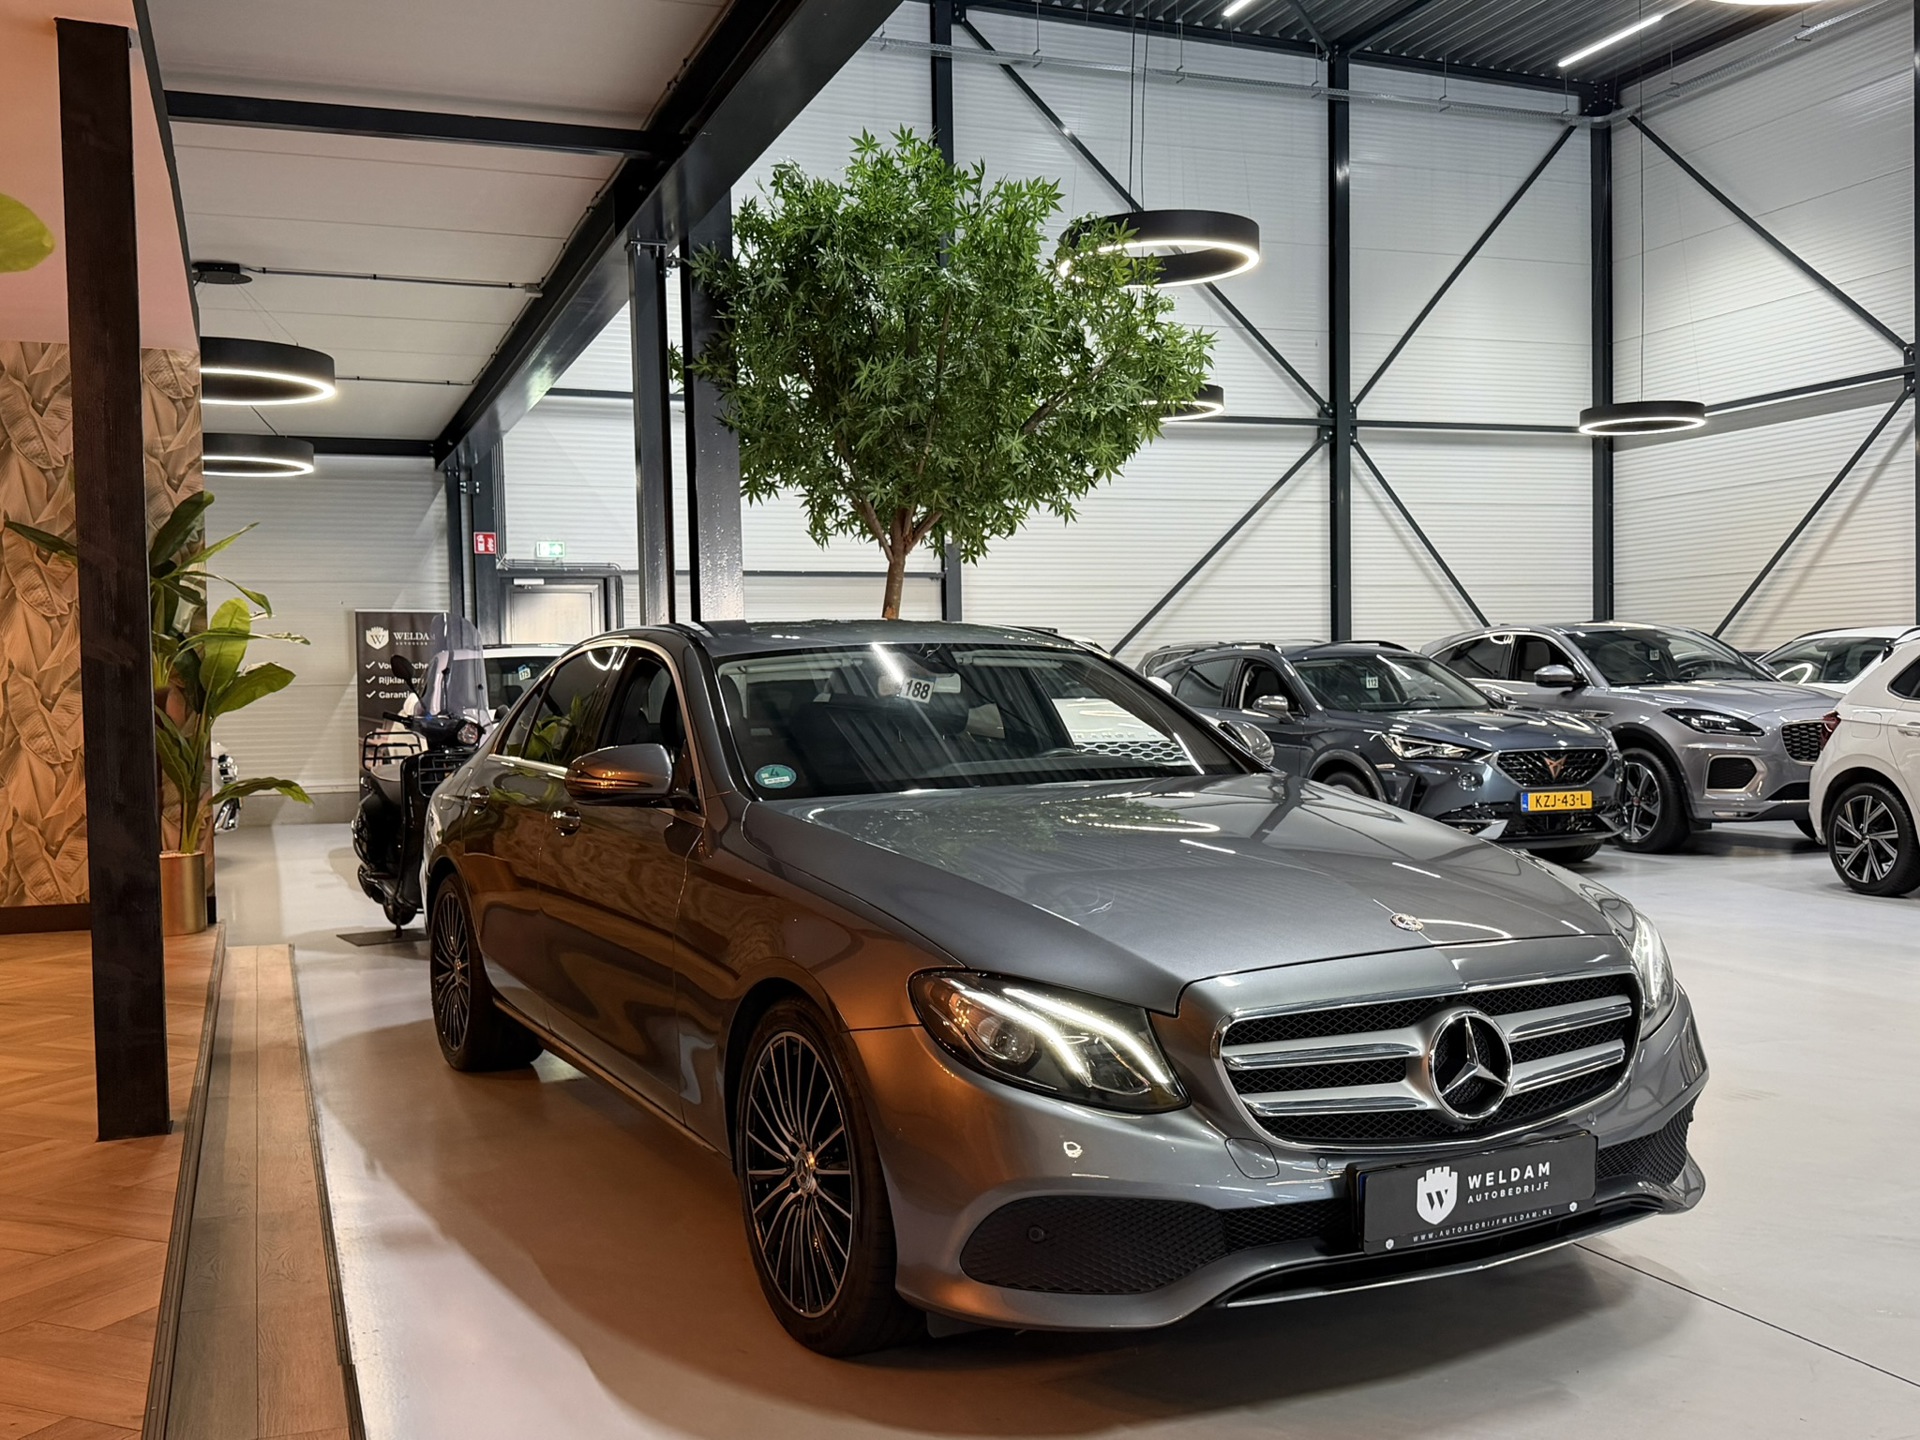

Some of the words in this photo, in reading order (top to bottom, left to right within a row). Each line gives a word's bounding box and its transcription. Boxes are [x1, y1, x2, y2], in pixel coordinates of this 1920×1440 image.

[370, 634, 385, 645] W
[378, 691, 410, 699] Garanti
[906, 679, 931, 700] 188
[1535, 794, 1587, 808] KZJ-43-L
[1467, 1161, 1551, 1190] WELDAM
[1425, 1188, 1449, 1211] W
[1467, 1181, 1550, 1204] AUTOBEDRIJF
[1412, 1208, 1553, 1243] WWW.AUTOBEDRIJFWELDAM.NL
